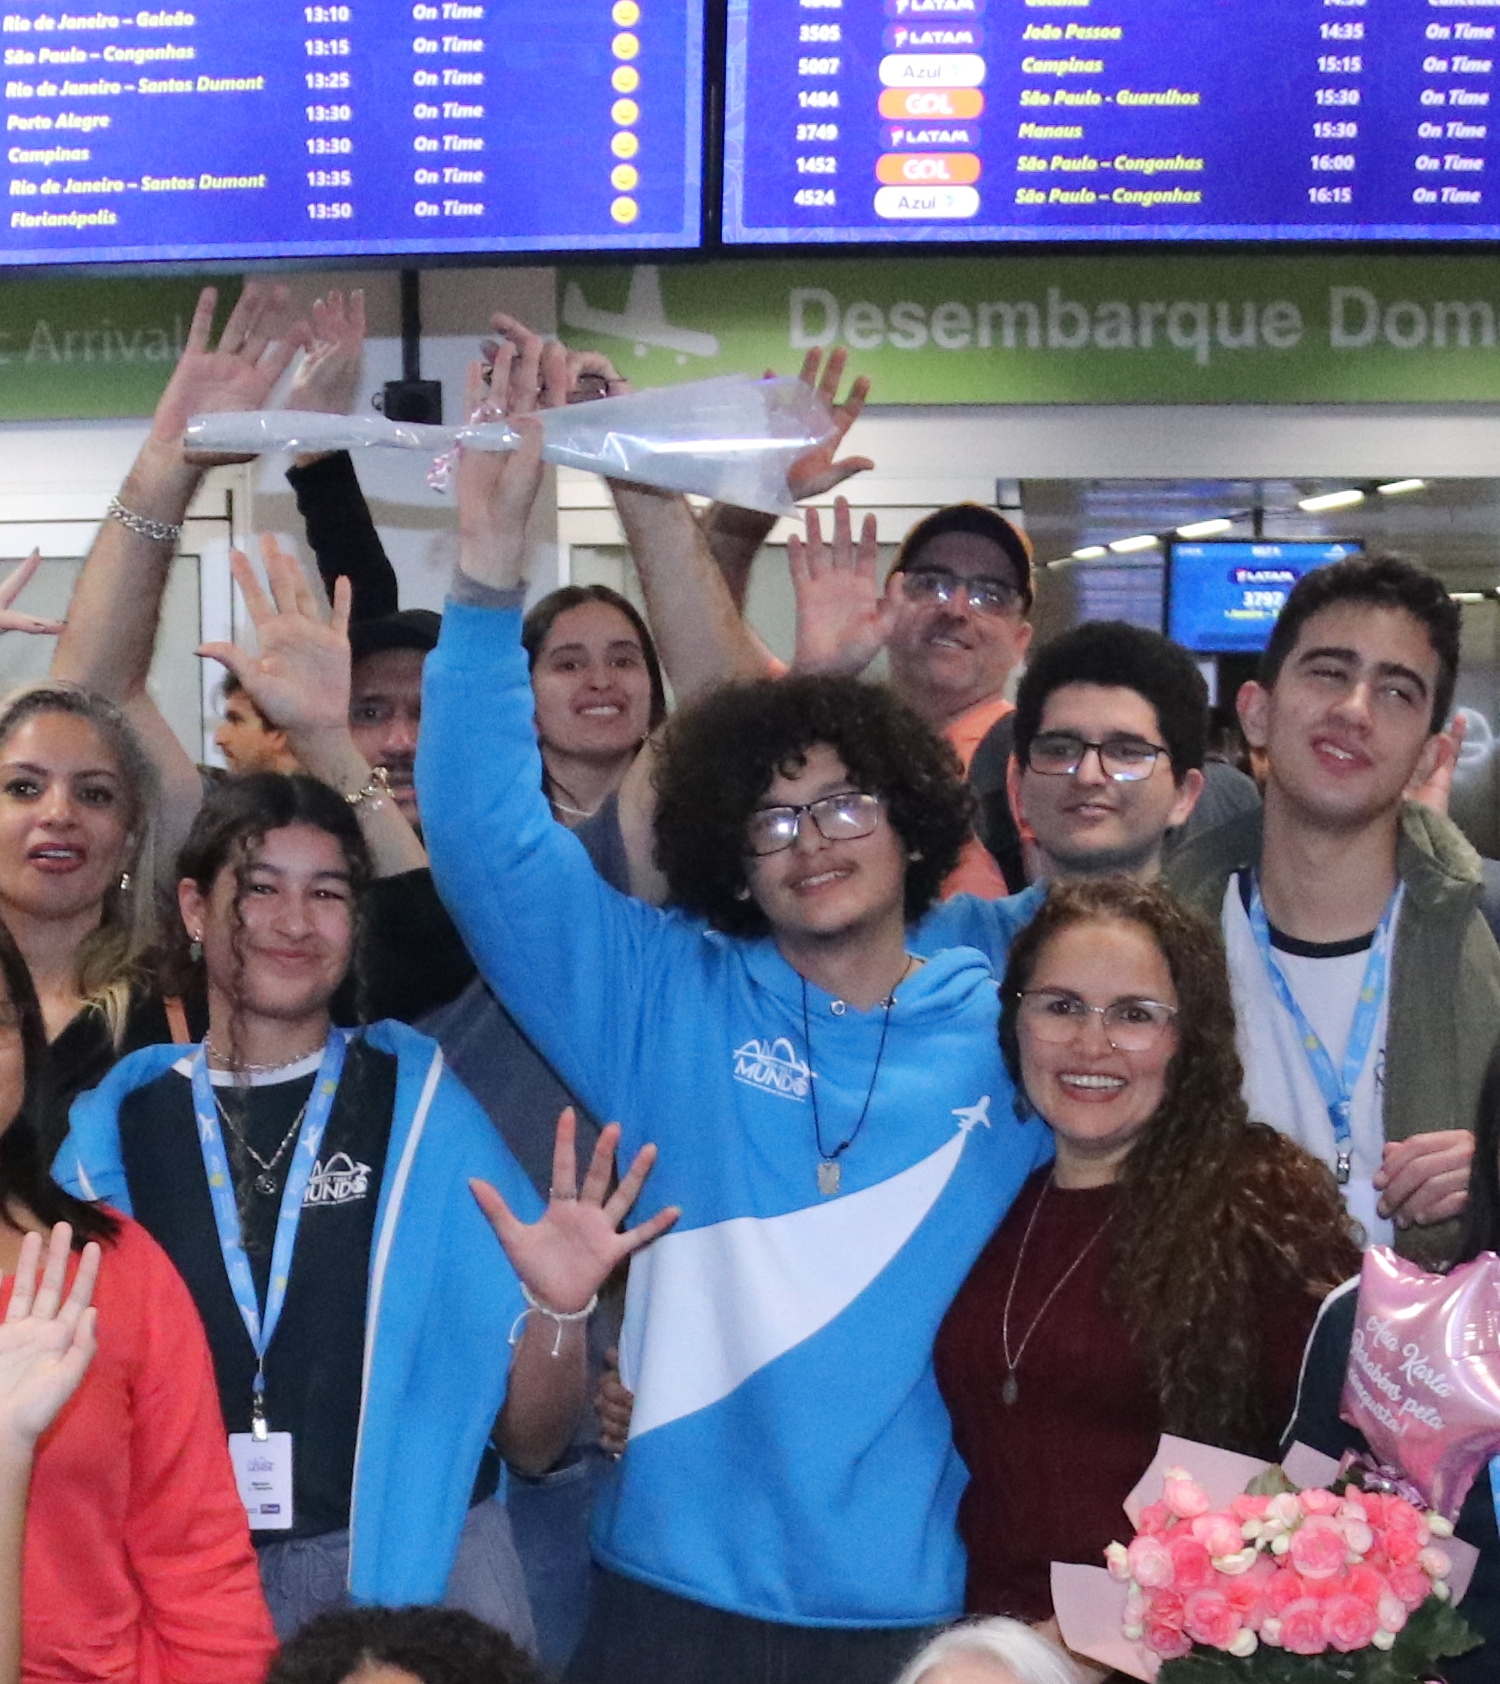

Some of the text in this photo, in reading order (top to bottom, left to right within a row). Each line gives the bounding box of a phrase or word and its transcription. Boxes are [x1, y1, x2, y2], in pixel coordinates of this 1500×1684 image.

[3, 14, 32, 32] Rio
[33, 14, 57, 31] de
[56, 12, 121, 32] Janeiro
[135, 10, 196, 28] Galeão
[305, 6, 351, 23] 13:10
[413, 4, 439, 20] On
[443, 3, 485, 19] Time
[799, 23, 1496, 45] 3505 LATAM João Pessoa 14:35 On Time
[4, 47, 37, 65] São
[38, 45, 89, 64] Paulo
[102, 43, 196, 65] Congonhas
[305, 39, 350, 56] 13:15
[414, 37, 439, 53] On
[443, 36, 485, 53] Time
[798, 56, 1494, 78] 5007 Azul Campinas 15:15 On Time
[6, 80, 35, 98] Rio
[36, 80, 60, 97] de
[58, 78, 123, 97] Janeiro
[137, 77, 193, 95] Santos
[194, 75, 265, 93] Dumont
[306, 72, 351, 89] 13:25
[414, 70, 440, 86] On
[443, 69, 485, 85] Time
[905, 93, 954, 115] GOL
[1019, 90, 1054, 107] São
[1052, 89, 1104, 107] Paulo
[1115, 89, 1202, 107] Guarulhos
[1316, 89, 1361, 106] 15:30
[1421, 90, 1447, 106] On
[1450, 89, 1491, 106] Time
[7, 115, 54, 132] Porto
[54, 112, 112, 134] Alegre
[307, 105, 352, 122] 13:30
[414, 103, 440, 119] On
[443, 102, 485, 118] Time
[796, 122, 1488, 144] 3749 LATAM Manaus 15:30 On Time
[8, 145, 91, 166] Campinas
[307, 138, 352, 154] 13:30
[415, 136, 440, 152] On
[444, 135, 485, 151] Time
[9, 178, 39, 196] Rio
[40, 178, 63, 195] de
[62, 176, 126, 195] Janeiro
[140, 175, 196, 192] Santos
[197, 173, 267, 191] Dumont
[308, 170, 352, 187] 13:35
[415, 169, 440, 184] On
[444, 167, 485, 183] Time
[796, 154, 1485, 180] 1452 GOL São Paulo Congonhas 16:00 On Time
[794, 186, 1482, 210] 4524 Azul São Paulo Congonhas 16:15 On Time
[11, 209, 118, 230] Florianópolis
[308, 203, 353, 219] 13:50
[415, 201, 440, 216] On
[444, 200, 485, 215] Time
[26, 315, 186, 363] Arrival
[788, 286, 1303, 363] Desembarque
[734, 1056, 809, 1097] MUNDO
